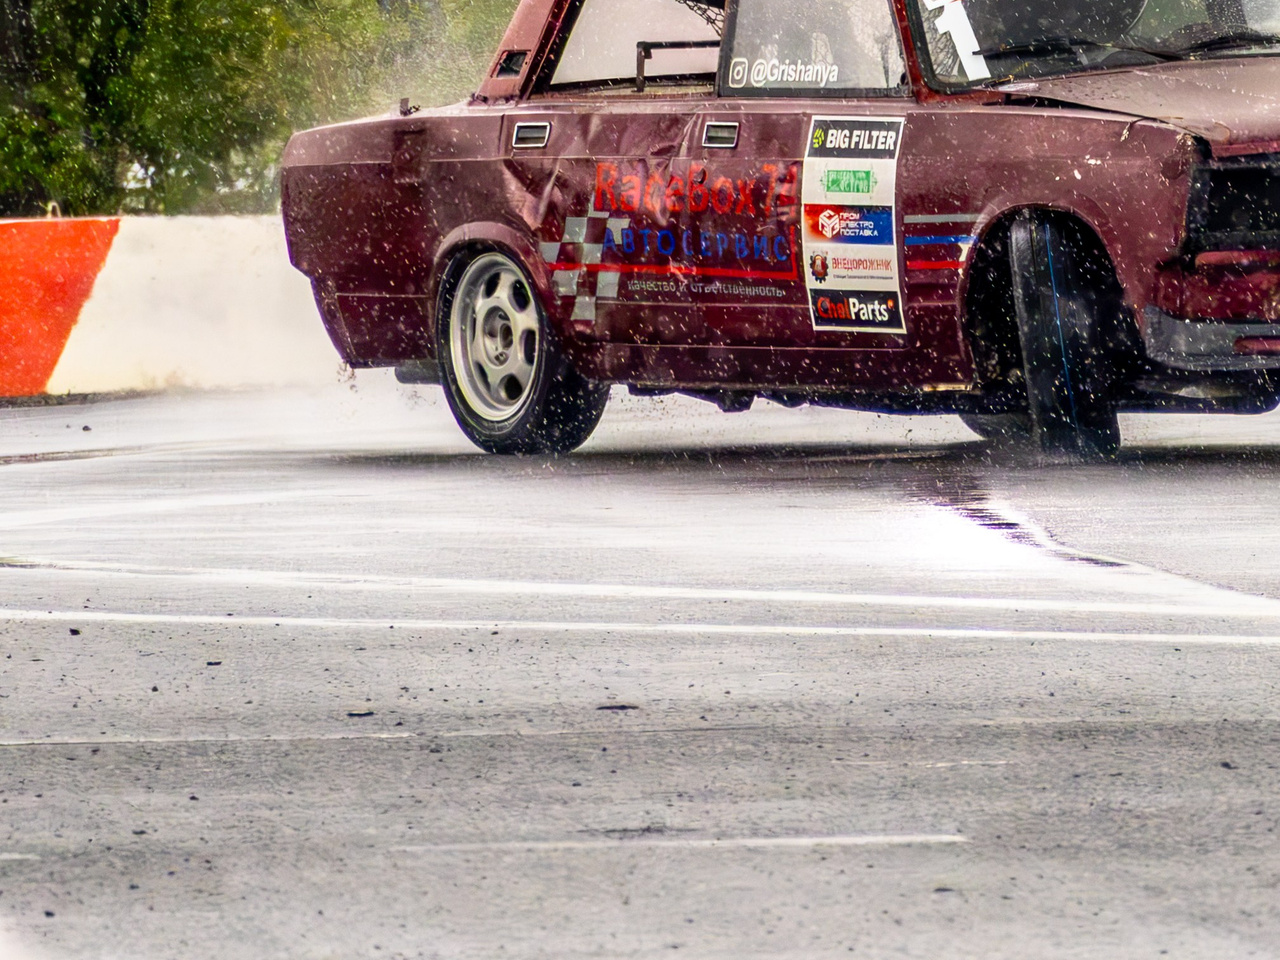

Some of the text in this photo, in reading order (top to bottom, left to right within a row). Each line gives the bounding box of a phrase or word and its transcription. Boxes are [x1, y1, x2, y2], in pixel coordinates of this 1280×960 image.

[935, 1, 992, 81] 1
[751, 58, 838, 87] @Grishanya
[826, 129, 896, 150] BIG FILTER
[603, 227, 789, 262] АВТОСЕРВИС
[840, 229, 879, 237] ПОСТАВКА
[832, 257, 892, 271] ВНЕДОРОЖНИК
[817, 296, 889, 321] ChelParts
